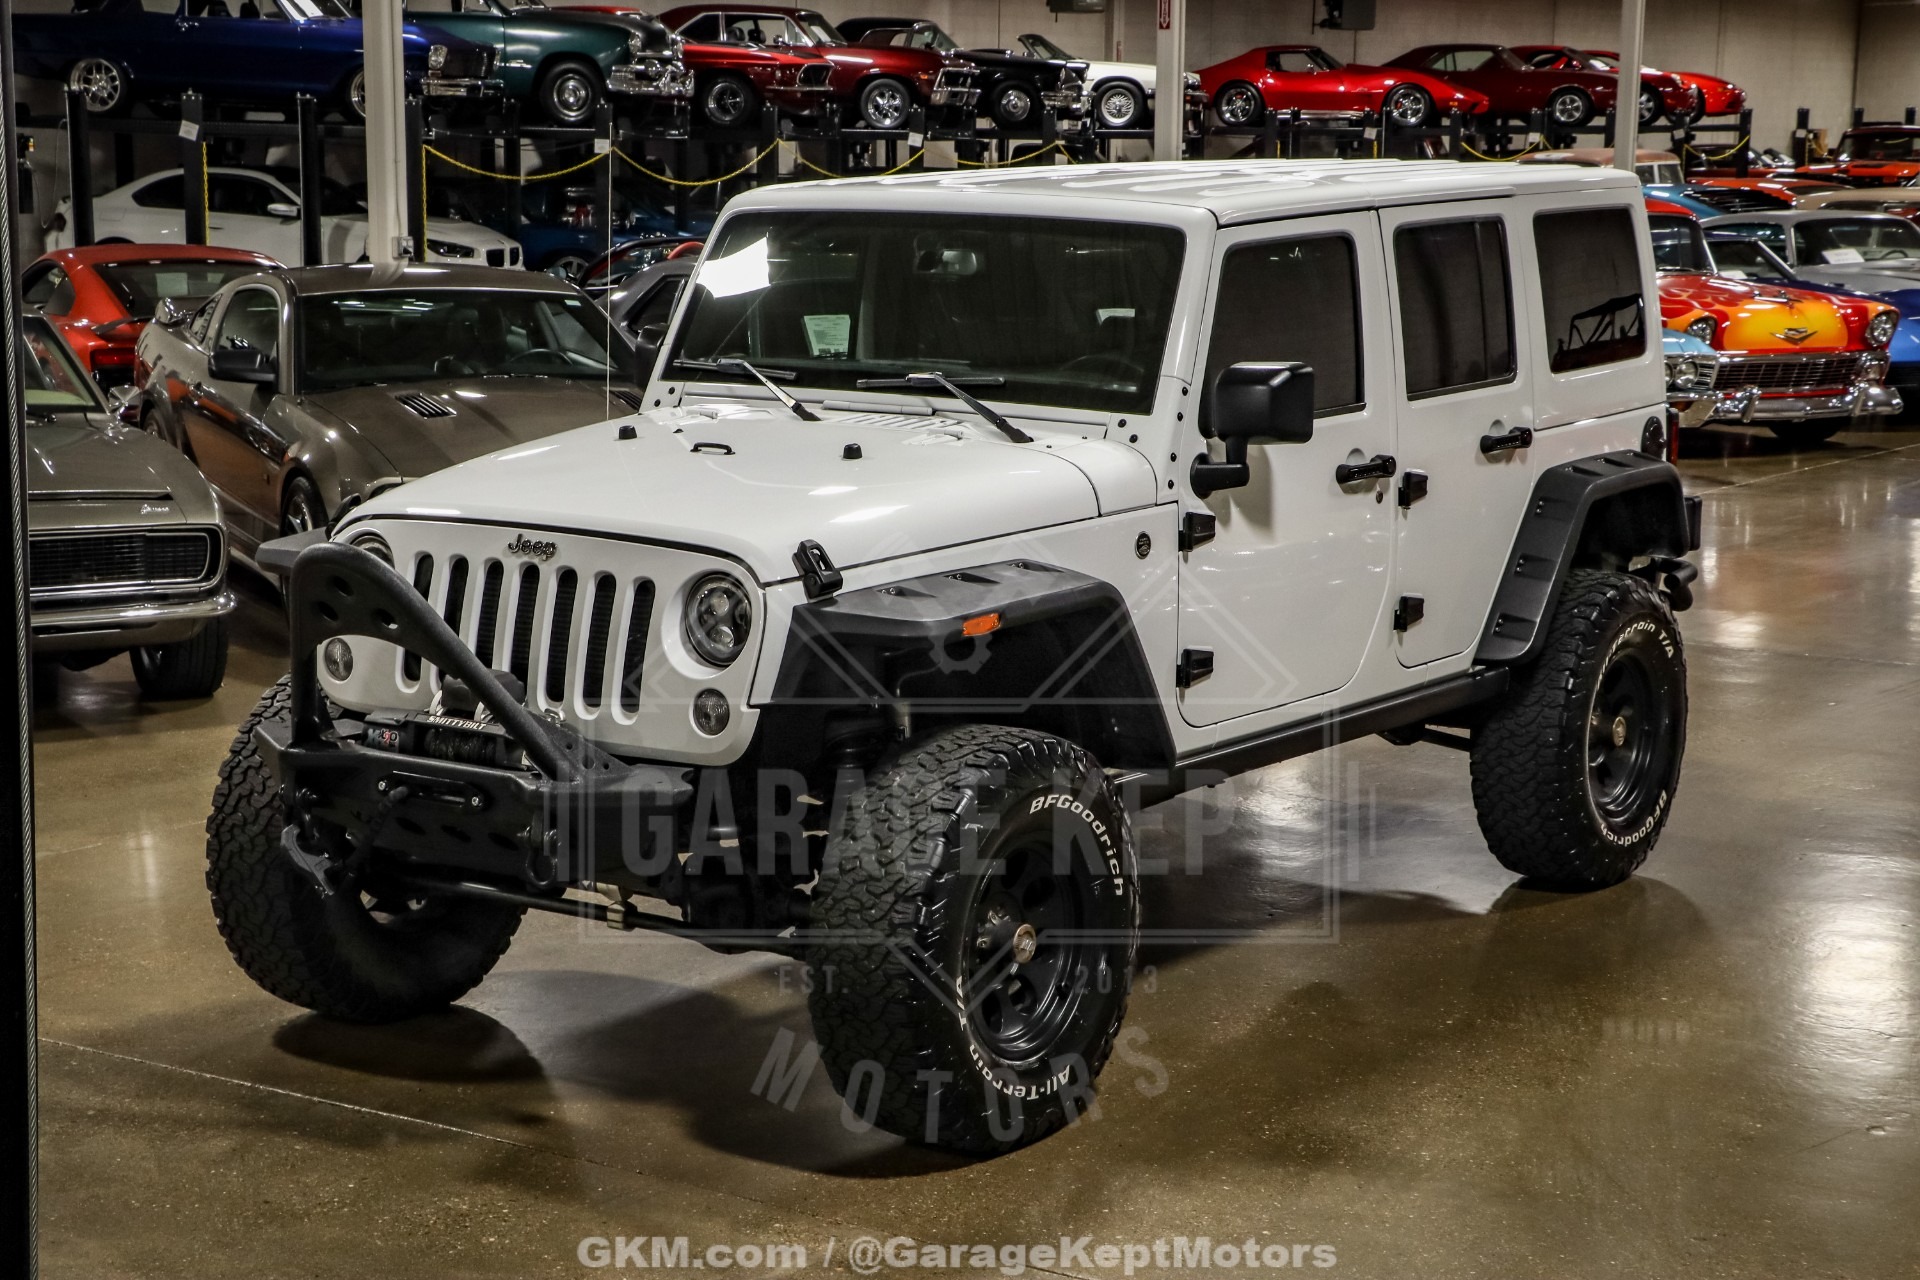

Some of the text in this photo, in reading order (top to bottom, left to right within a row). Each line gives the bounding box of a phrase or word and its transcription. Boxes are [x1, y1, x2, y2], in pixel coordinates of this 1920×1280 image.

[507, 533, 558, 561] Jeep
[426, 715, 487, 731] SMITTYBILT
[1029, 794, 1124, 896] BFGoodrich
[1600, 789, 1667, 848] BFGoodrich
[969, 1044, 1070, 1101] All-Terrain
